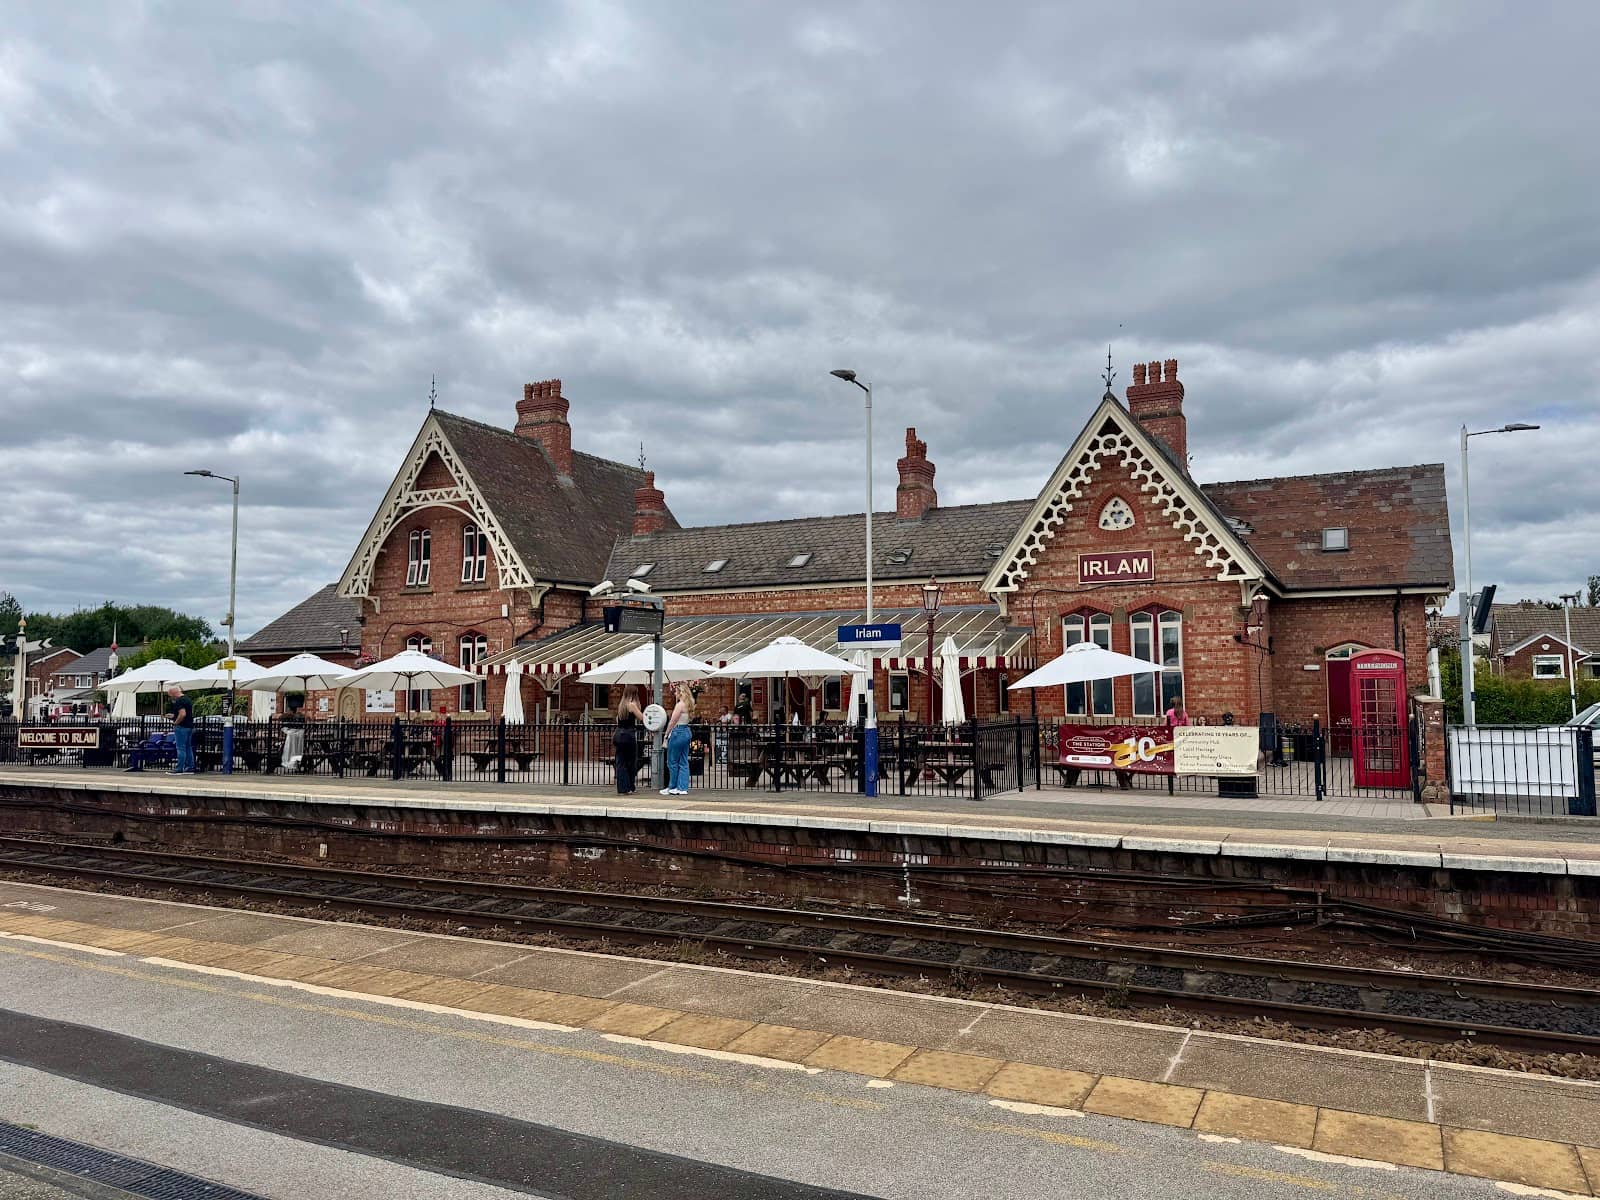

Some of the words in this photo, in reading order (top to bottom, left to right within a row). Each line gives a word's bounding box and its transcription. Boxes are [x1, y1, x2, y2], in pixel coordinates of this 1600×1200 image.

[1084, 558, 1148, 576] IRLAM
[855, 628, 882, 638] Irlam
[21, 733, 56, 742] WELCOME
[59, 733, 69, 743] TO
[72, 733, 95, 743] IRLAM
[1124, 736, 1156, 761] 10
